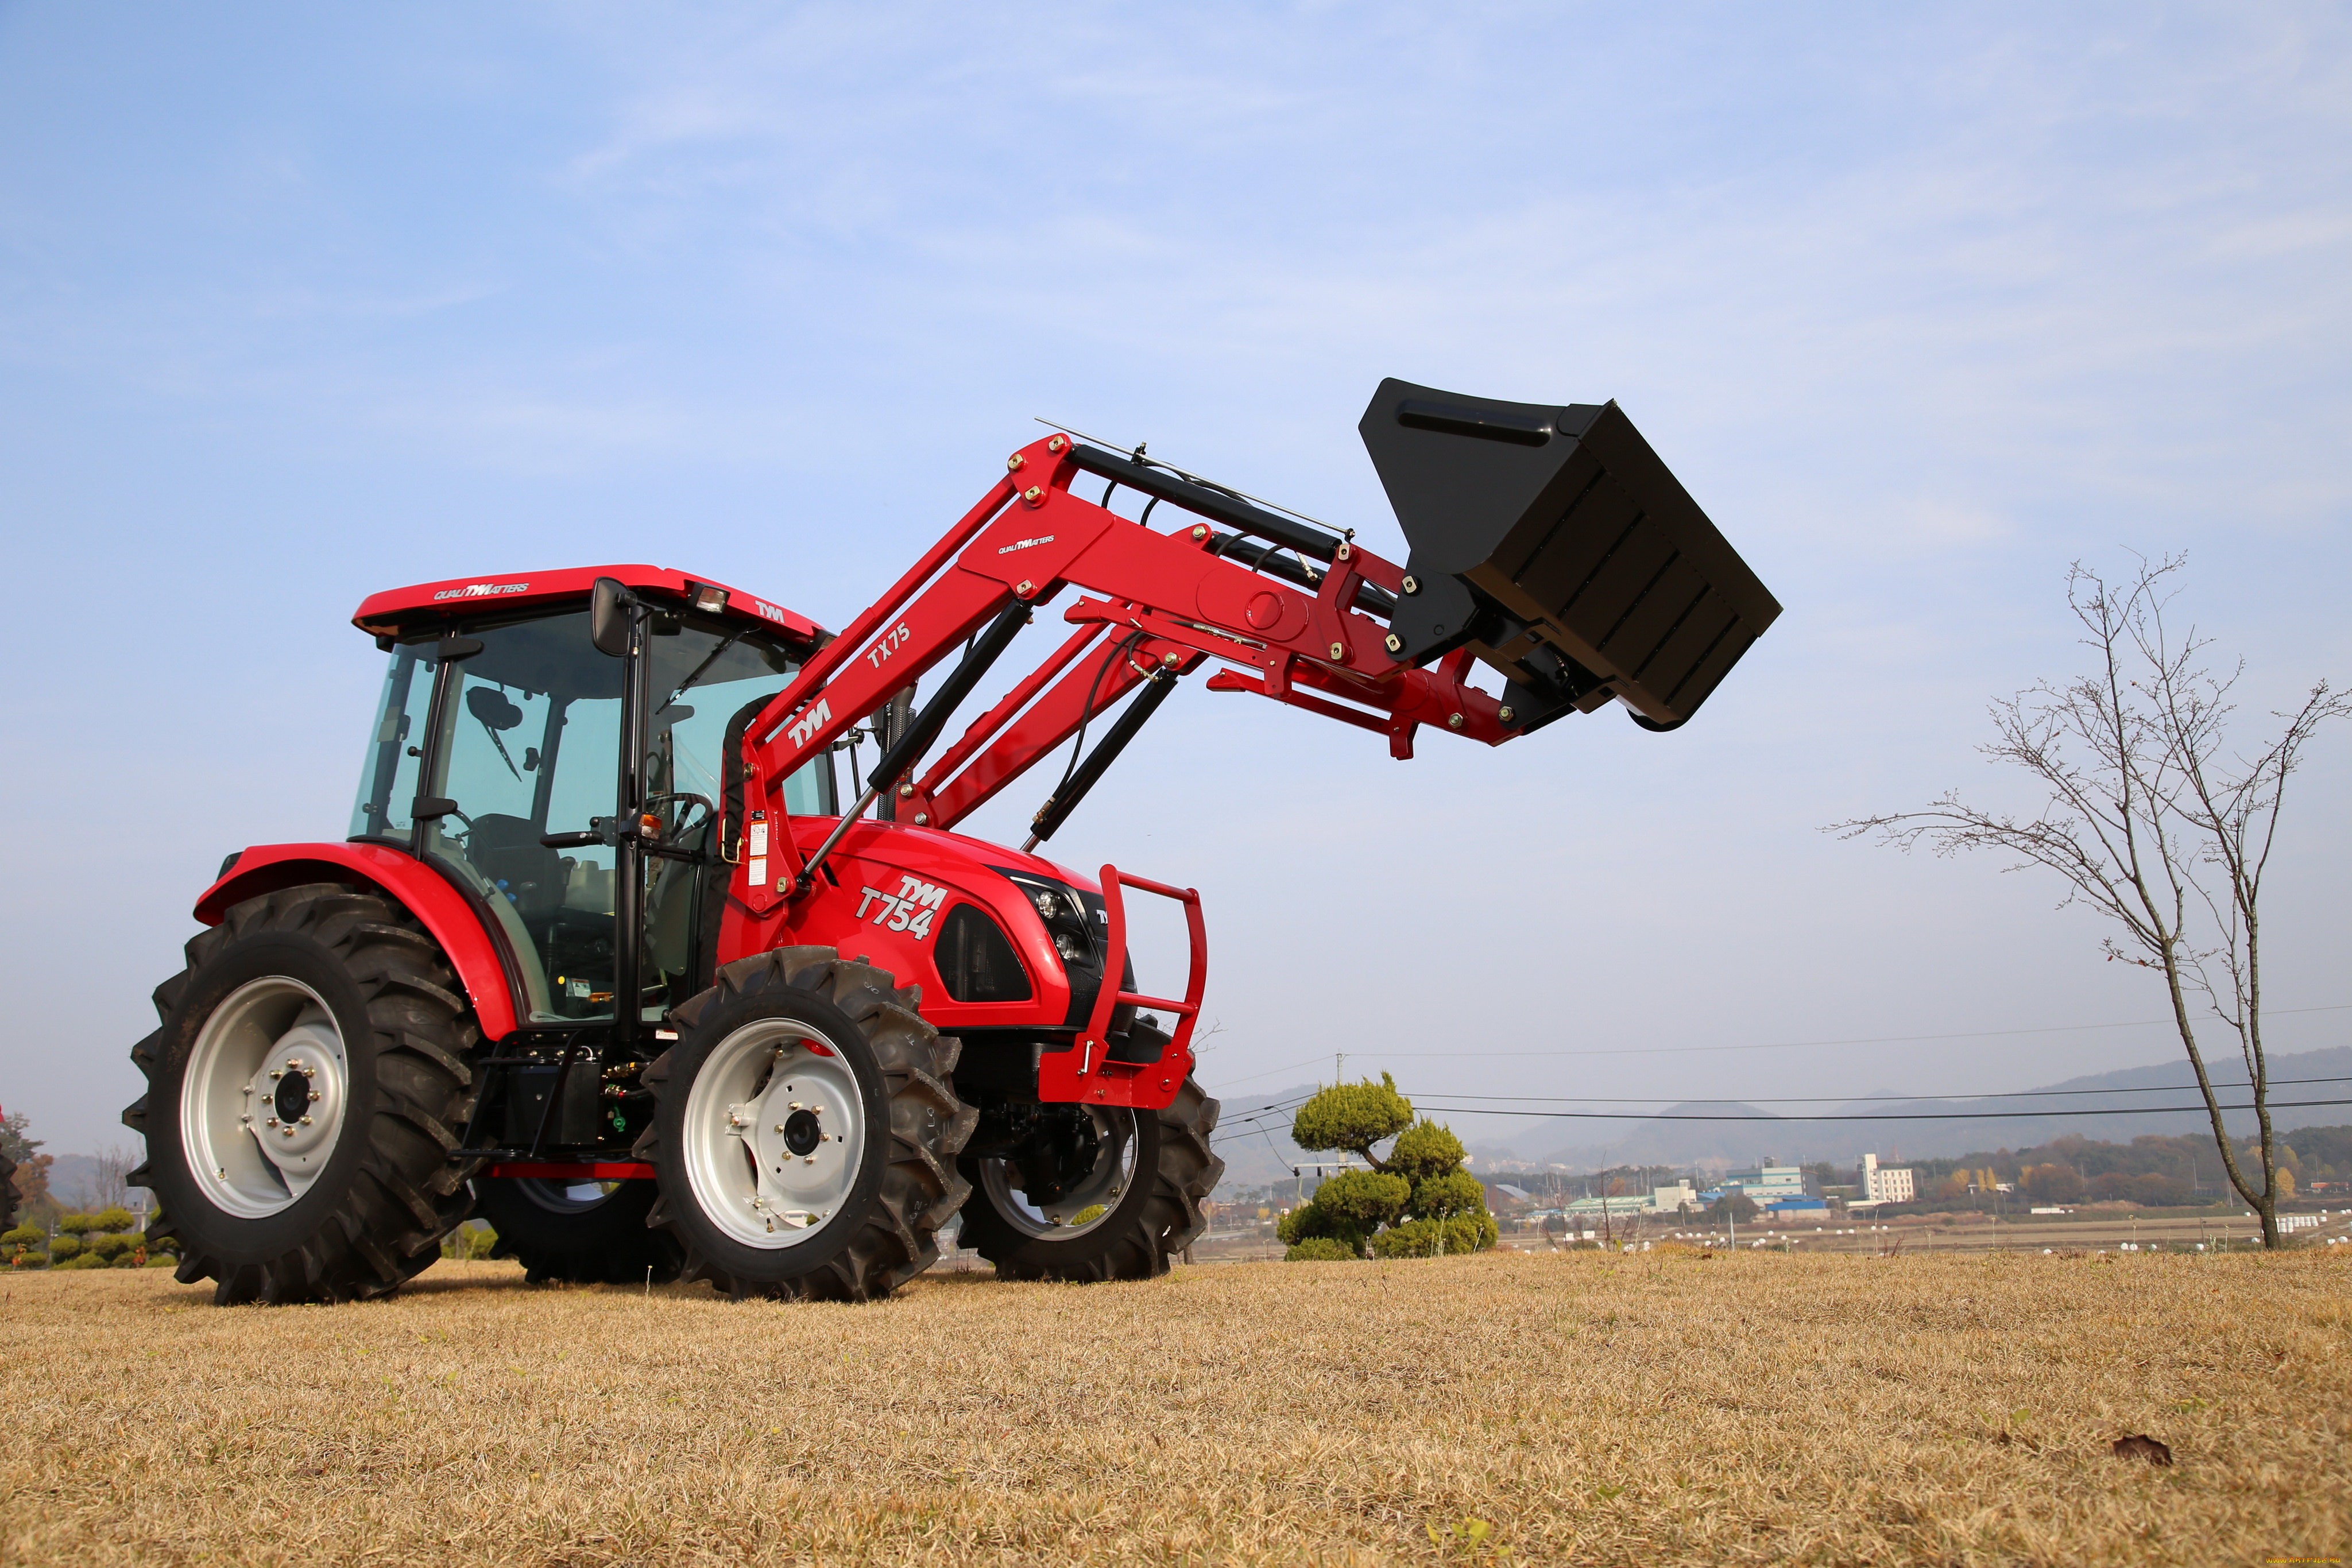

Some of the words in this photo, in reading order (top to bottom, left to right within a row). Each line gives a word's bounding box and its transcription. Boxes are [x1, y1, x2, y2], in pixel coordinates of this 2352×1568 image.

[755, 599, 785, 624] TYM
[866, 621, 910, 669] TX75
[787, 698, 832, 749] TYM
[855, 885, 931, 941] T754
[900, 874, 948, 911] TYM
[1096, 909, 1108, 924] TY
